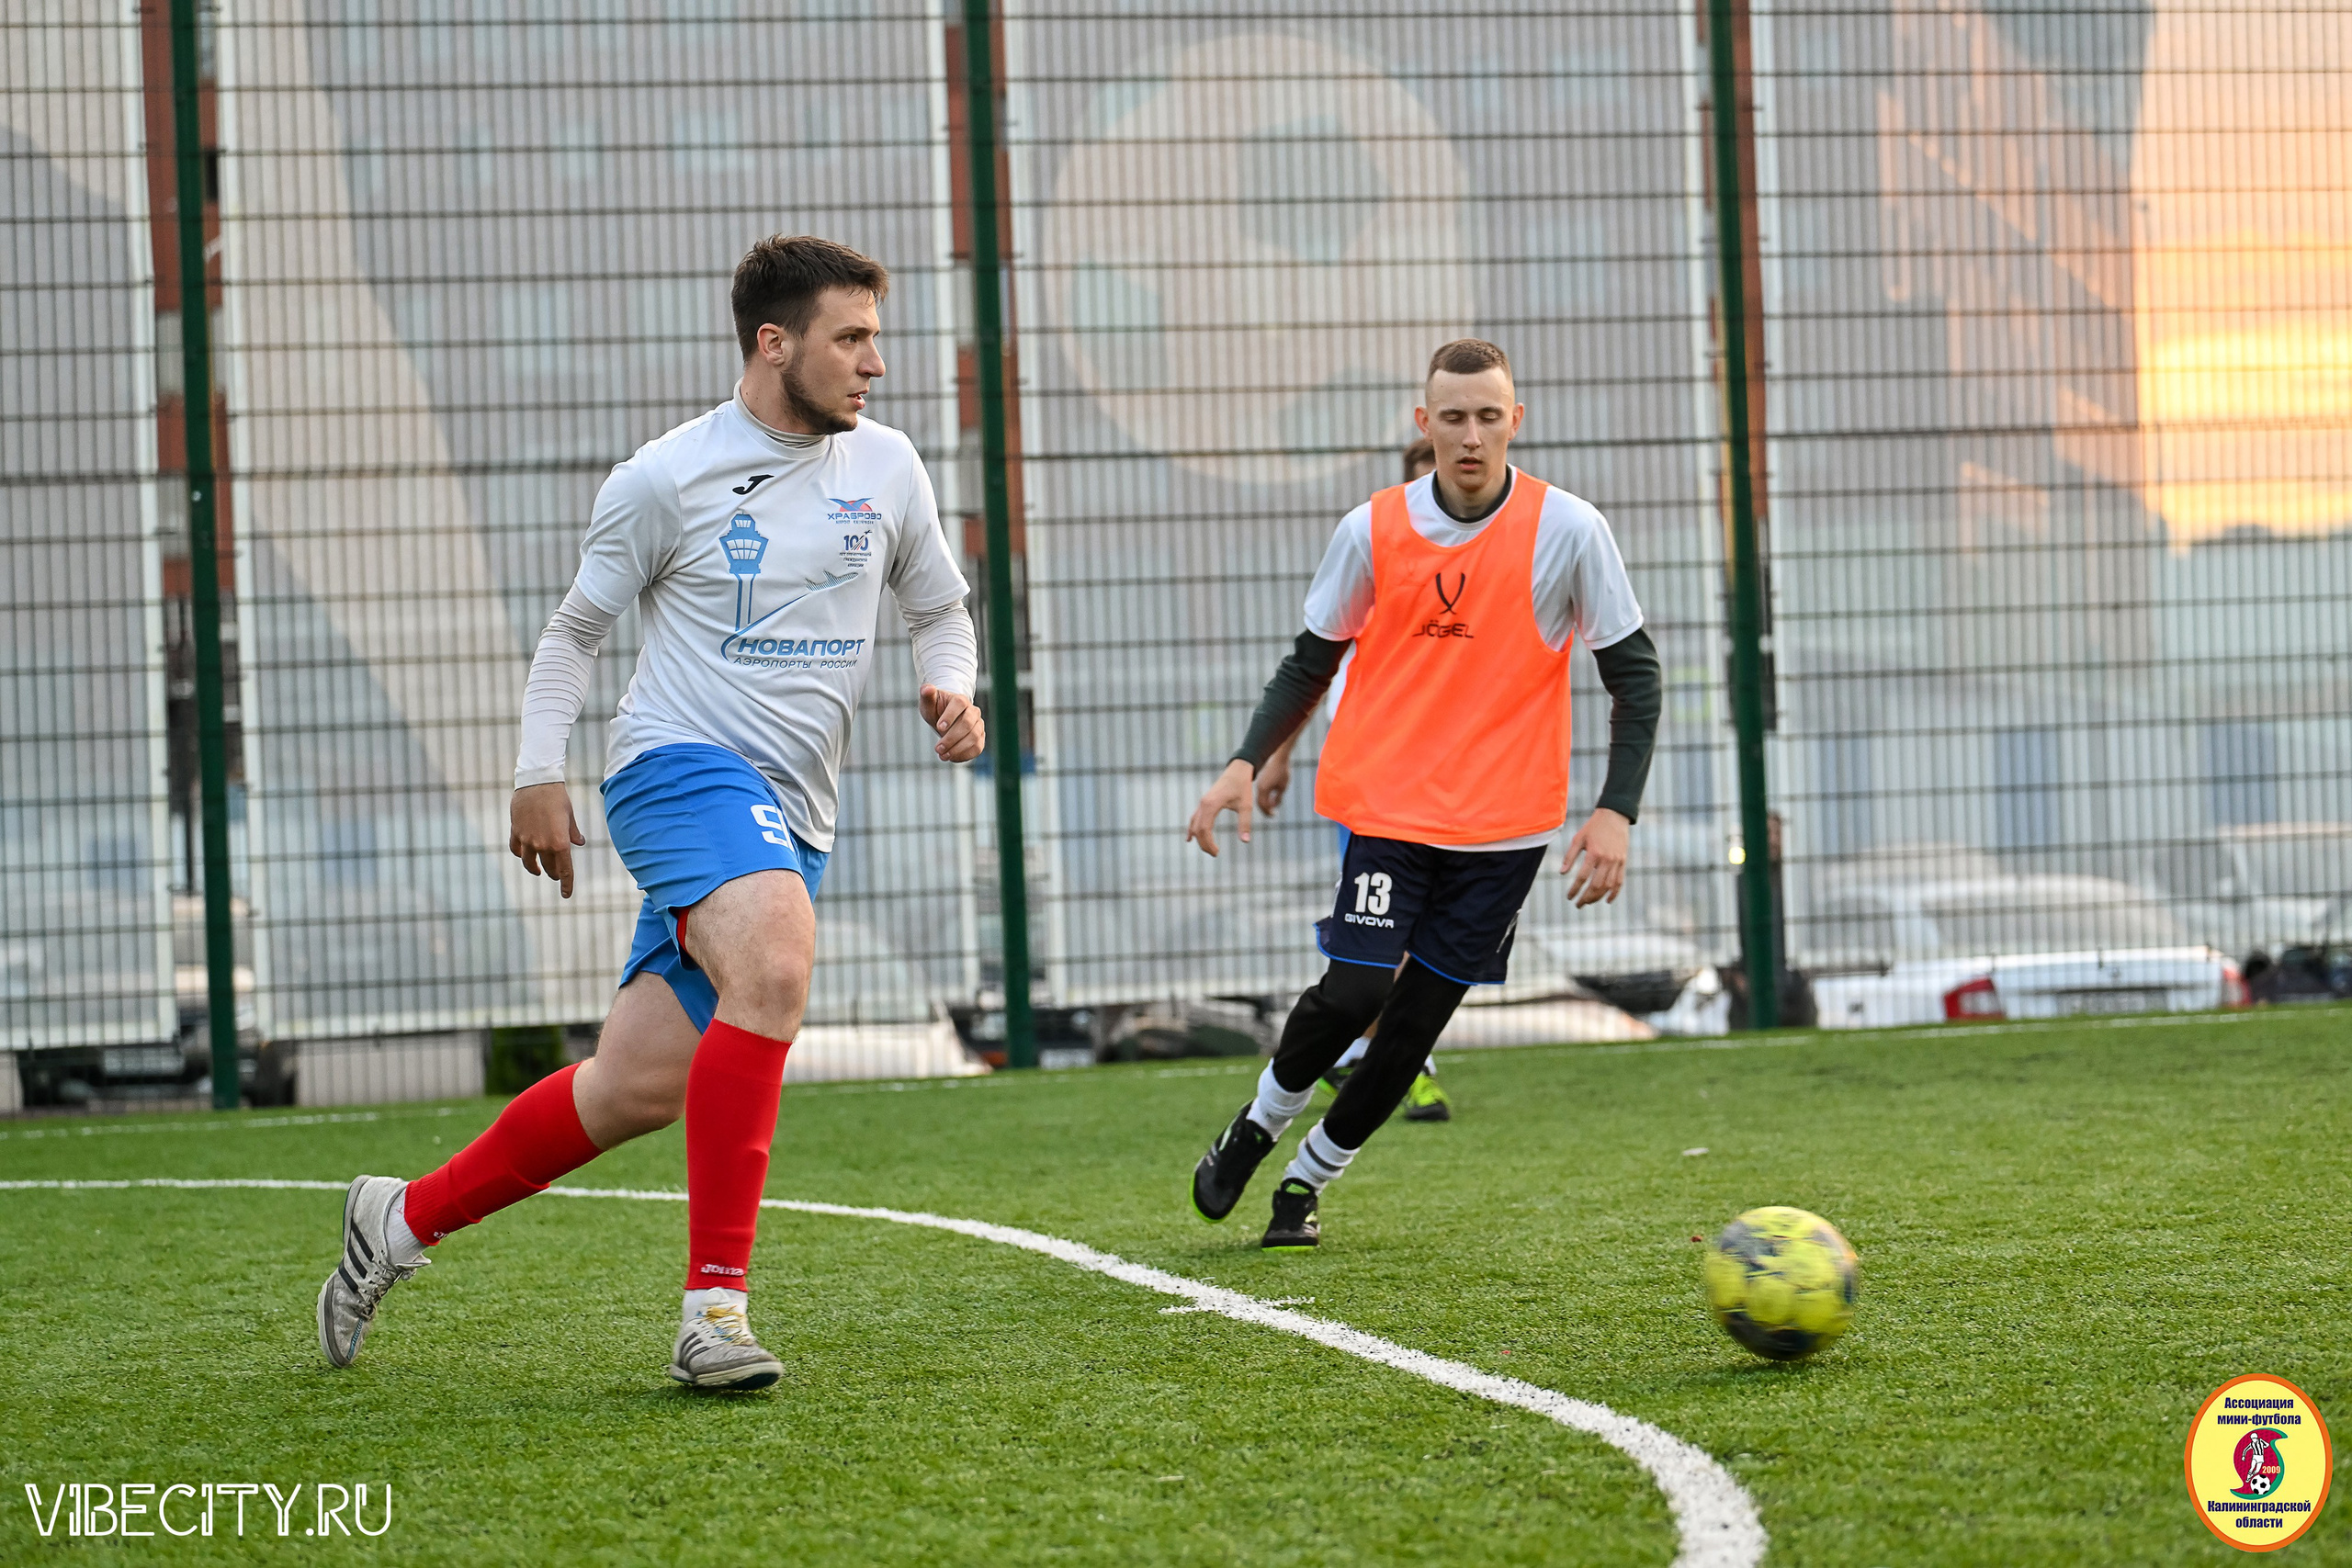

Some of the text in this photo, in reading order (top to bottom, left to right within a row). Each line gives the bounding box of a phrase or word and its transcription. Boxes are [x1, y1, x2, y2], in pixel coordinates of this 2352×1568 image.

[827, 512, 882, 520] ХРАБРОВО
[843, 535, 869, 551] 100
[1412, 619, 1475, 638] JÖGEL
[737, 638, 865, 657] НОВАПОРТ
[733, 657, 857, 669] АЭРОПОРТЫ РОССИИ
[1354, 872, 1393, 916] 13
[1345, 913, 1394, 928] GIVOVA
